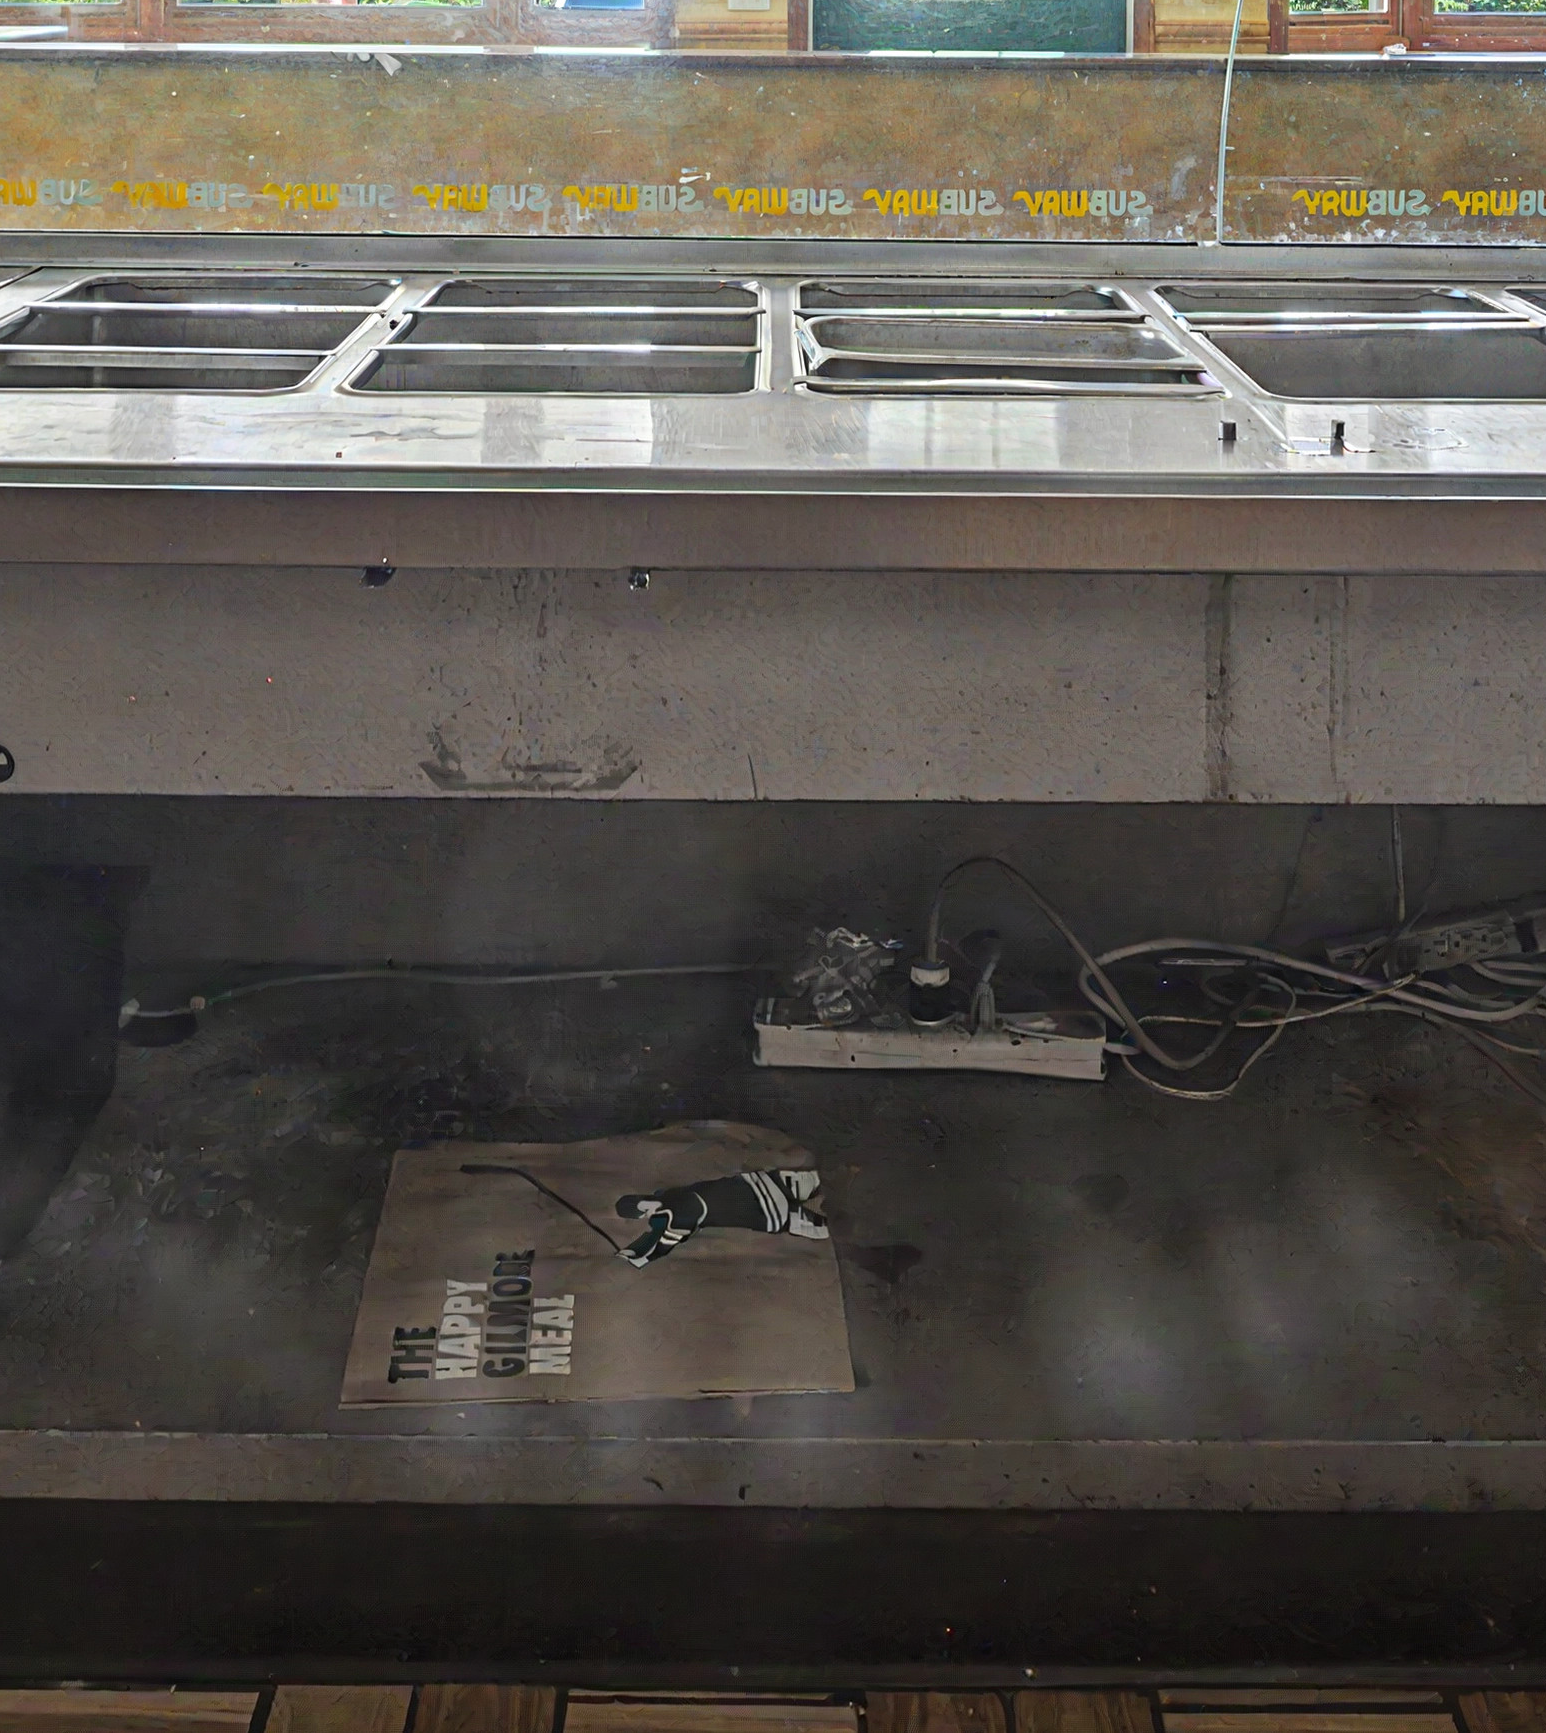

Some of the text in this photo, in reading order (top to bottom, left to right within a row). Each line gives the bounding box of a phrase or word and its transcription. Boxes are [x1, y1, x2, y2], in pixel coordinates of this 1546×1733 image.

[387, 1326, 436, 1384] THE
[435, 1279, 487, 1380] HAPPY
[529, 1294, 575, 1375] MEAL
